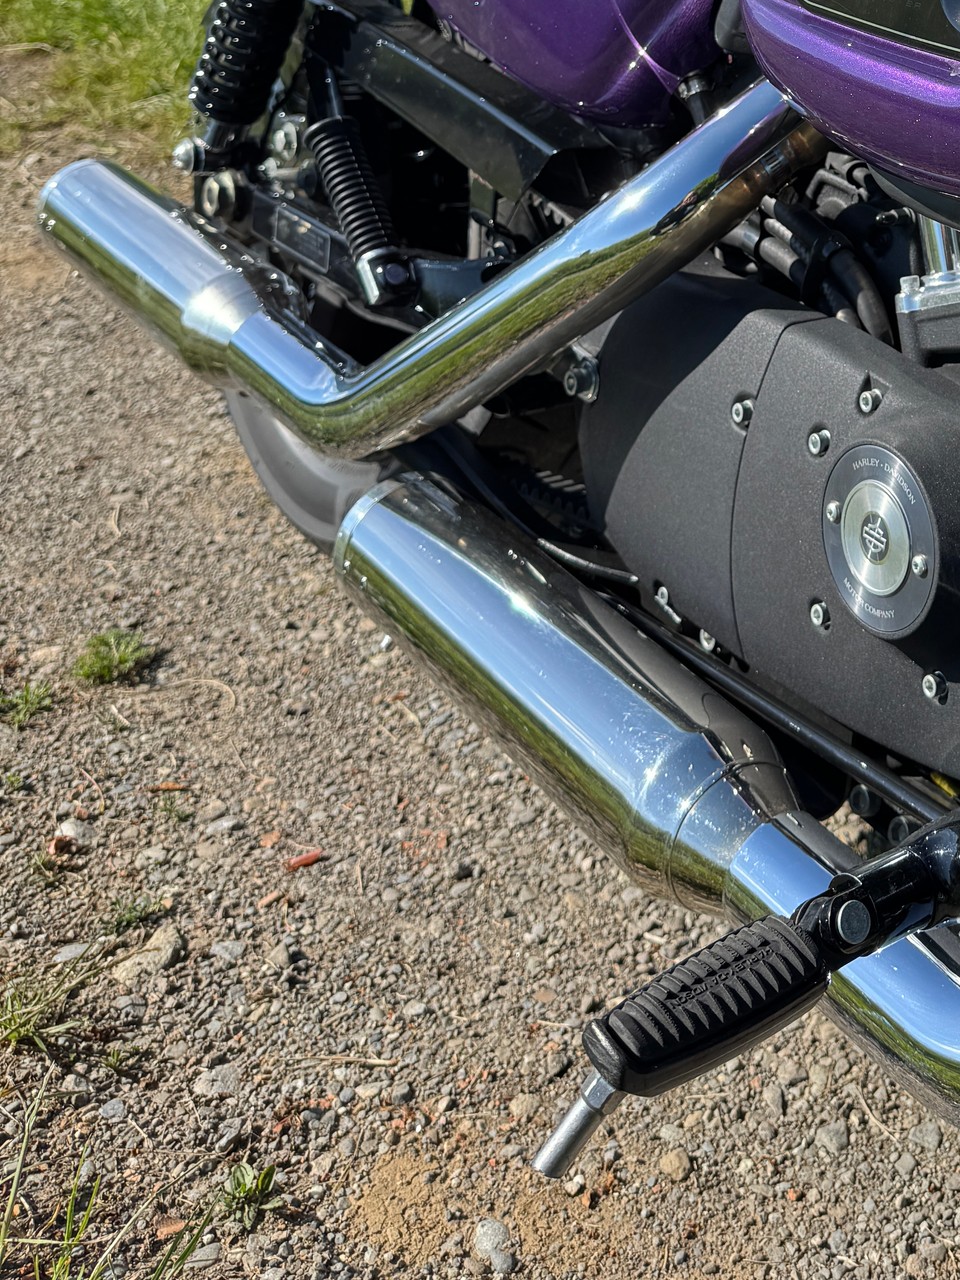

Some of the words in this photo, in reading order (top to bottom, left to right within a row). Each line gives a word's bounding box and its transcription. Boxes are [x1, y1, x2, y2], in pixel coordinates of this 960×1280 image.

[852, 458, 879, 471] HARLEY
[884, 463, 916, 505] DAVIDSON
[844, 577, 864, 608] MOTOR
[864, 603, 895, 619] COMPANY
